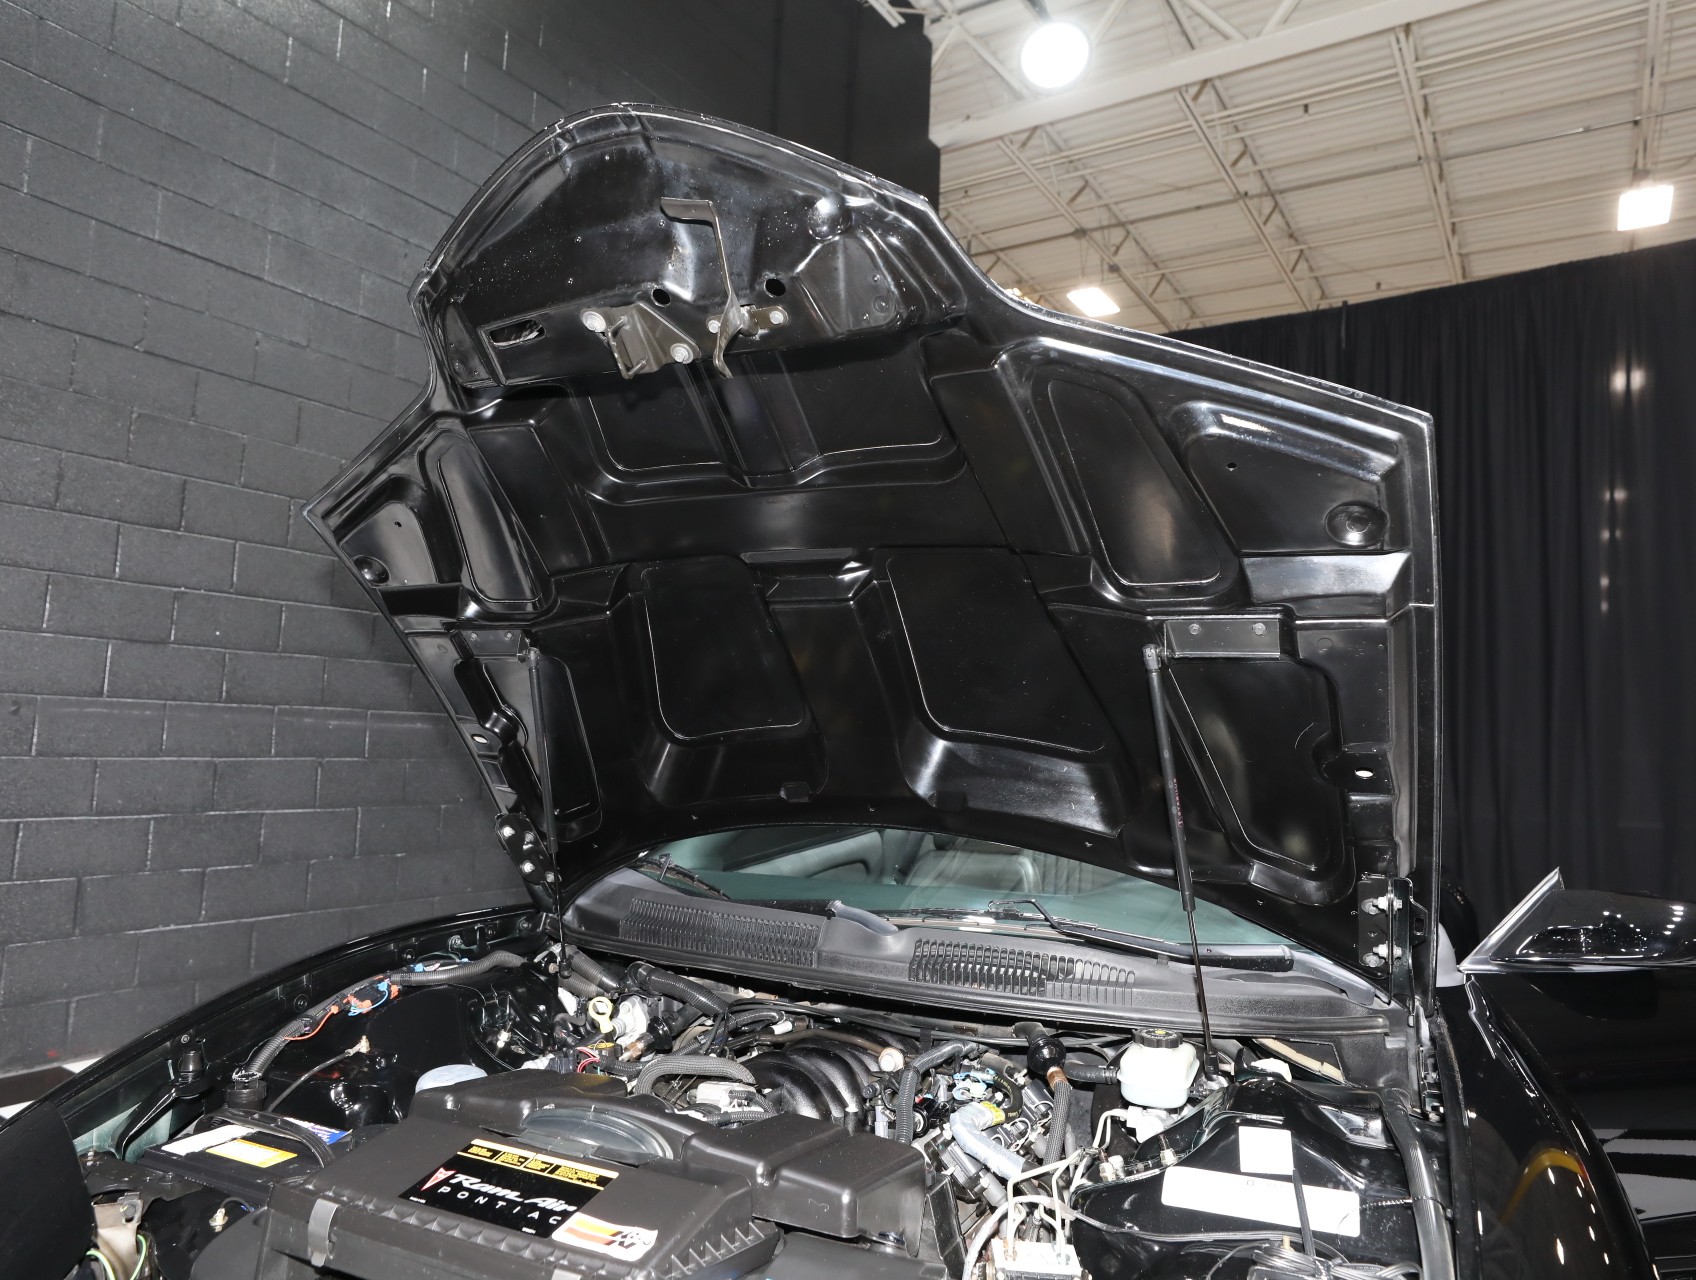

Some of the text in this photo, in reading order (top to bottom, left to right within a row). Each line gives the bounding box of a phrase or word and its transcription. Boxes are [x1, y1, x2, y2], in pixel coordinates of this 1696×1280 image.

[437, 1185, 562, 1225] PONTIAC
[449, 1173, 578, 1212] Ram Air
